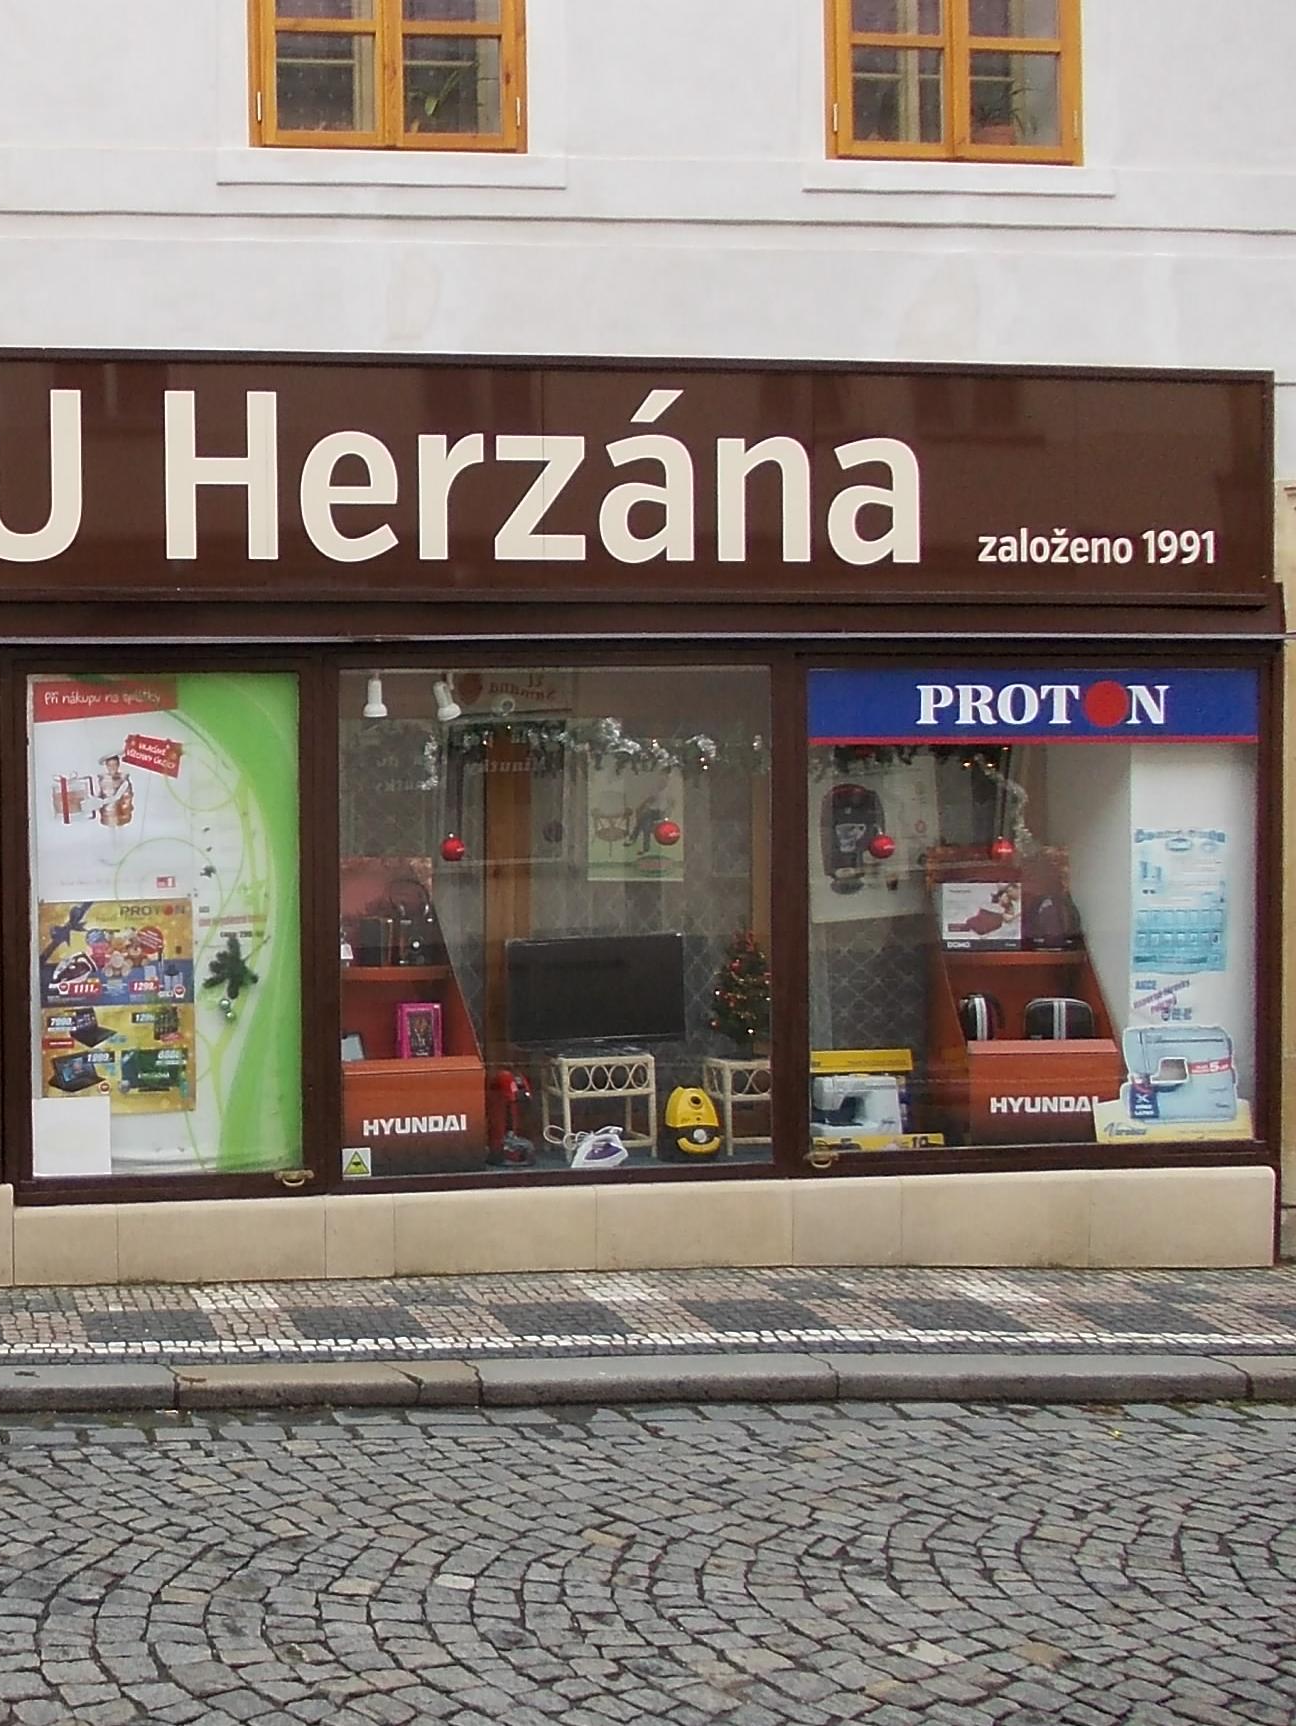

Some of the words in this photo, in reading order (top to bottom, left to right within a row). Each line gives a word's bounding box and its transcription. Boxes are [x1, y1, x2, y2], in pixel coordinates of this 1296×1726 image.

[164, 388, 921, 566] Herzána
[977, 526, 1133, 565] založeno
[1140, 529, 1216, 565] 1991
[916, 682, 1170, 727] PROTON
[362, 1113, 467, 1136] HYUNDAI
